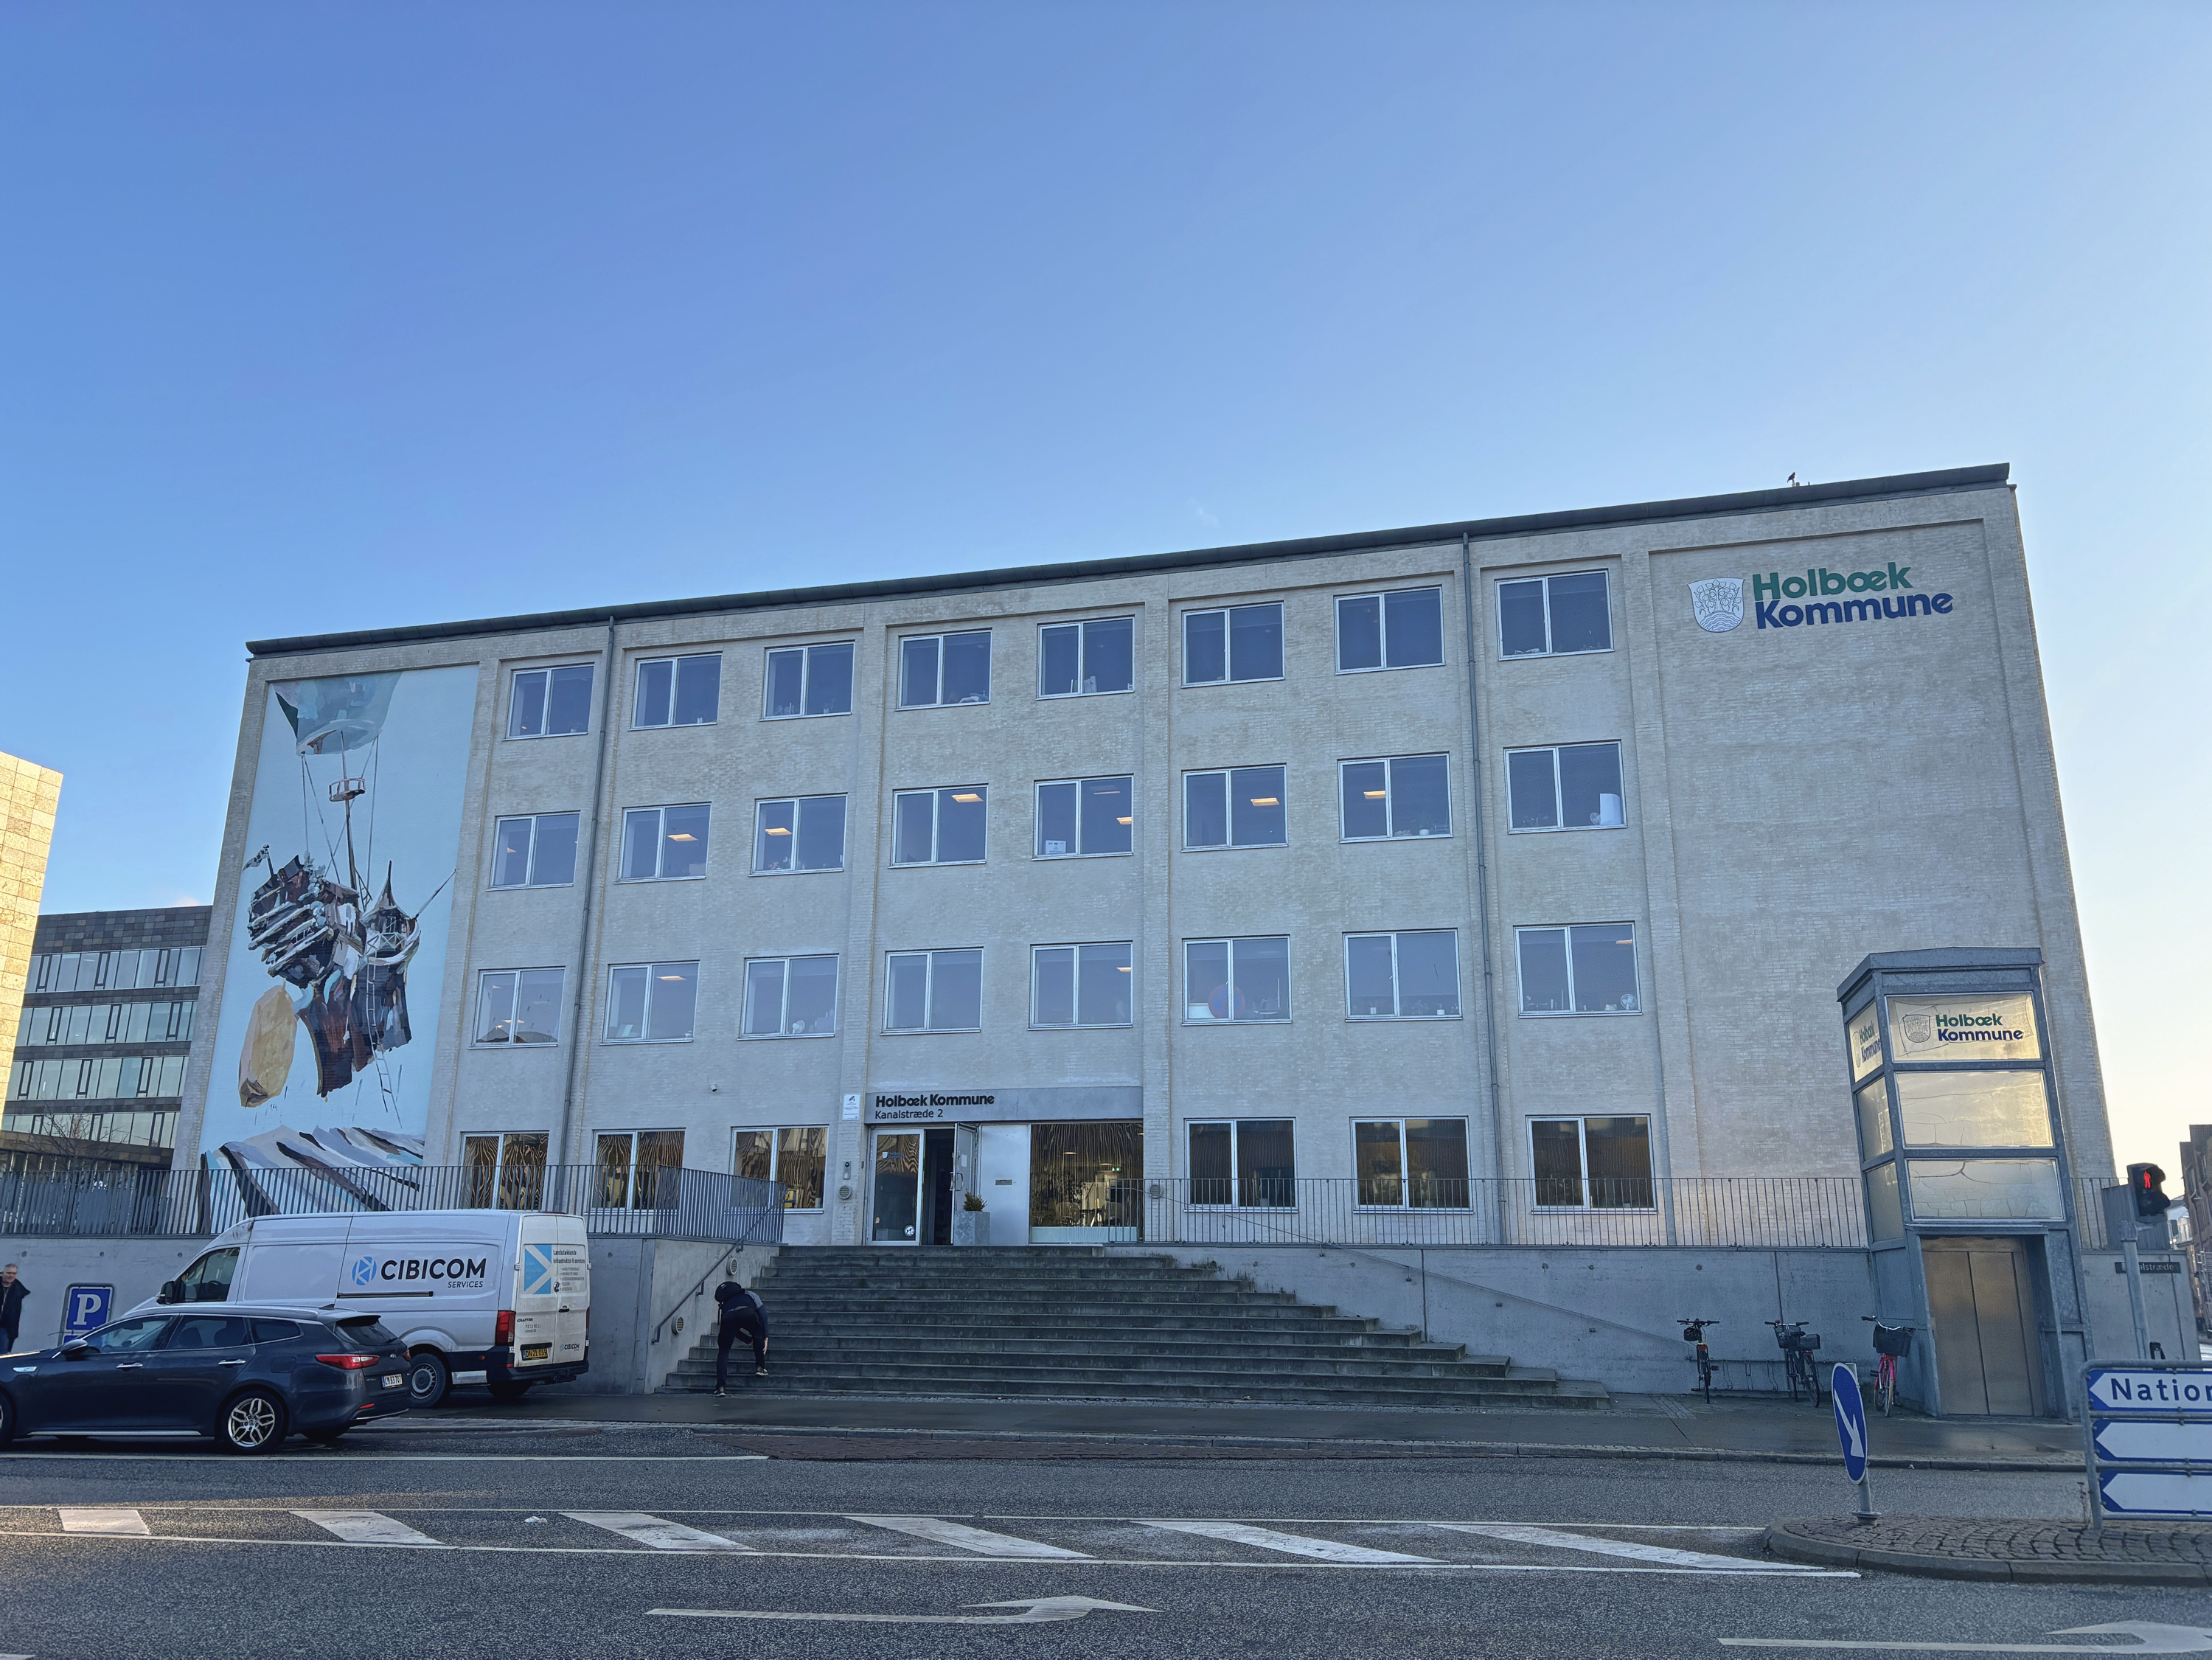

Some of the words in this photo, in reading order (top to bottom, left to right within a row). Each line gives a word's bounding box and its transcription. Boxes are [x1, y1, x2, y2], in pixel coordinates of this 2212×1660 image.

[1755, 593, 1953, 629] Kommune
[1937, 1029, 2024, 1041] Kommune
[930, 1094, 995, 1106] Kommune
[875, 1109, 934, 1119] Kanalstræde
[937, 1109, 943, 1117] 2
[381, 1258, 487, 1280] CIBICOM
[73, 1293, 102, 1325] P
